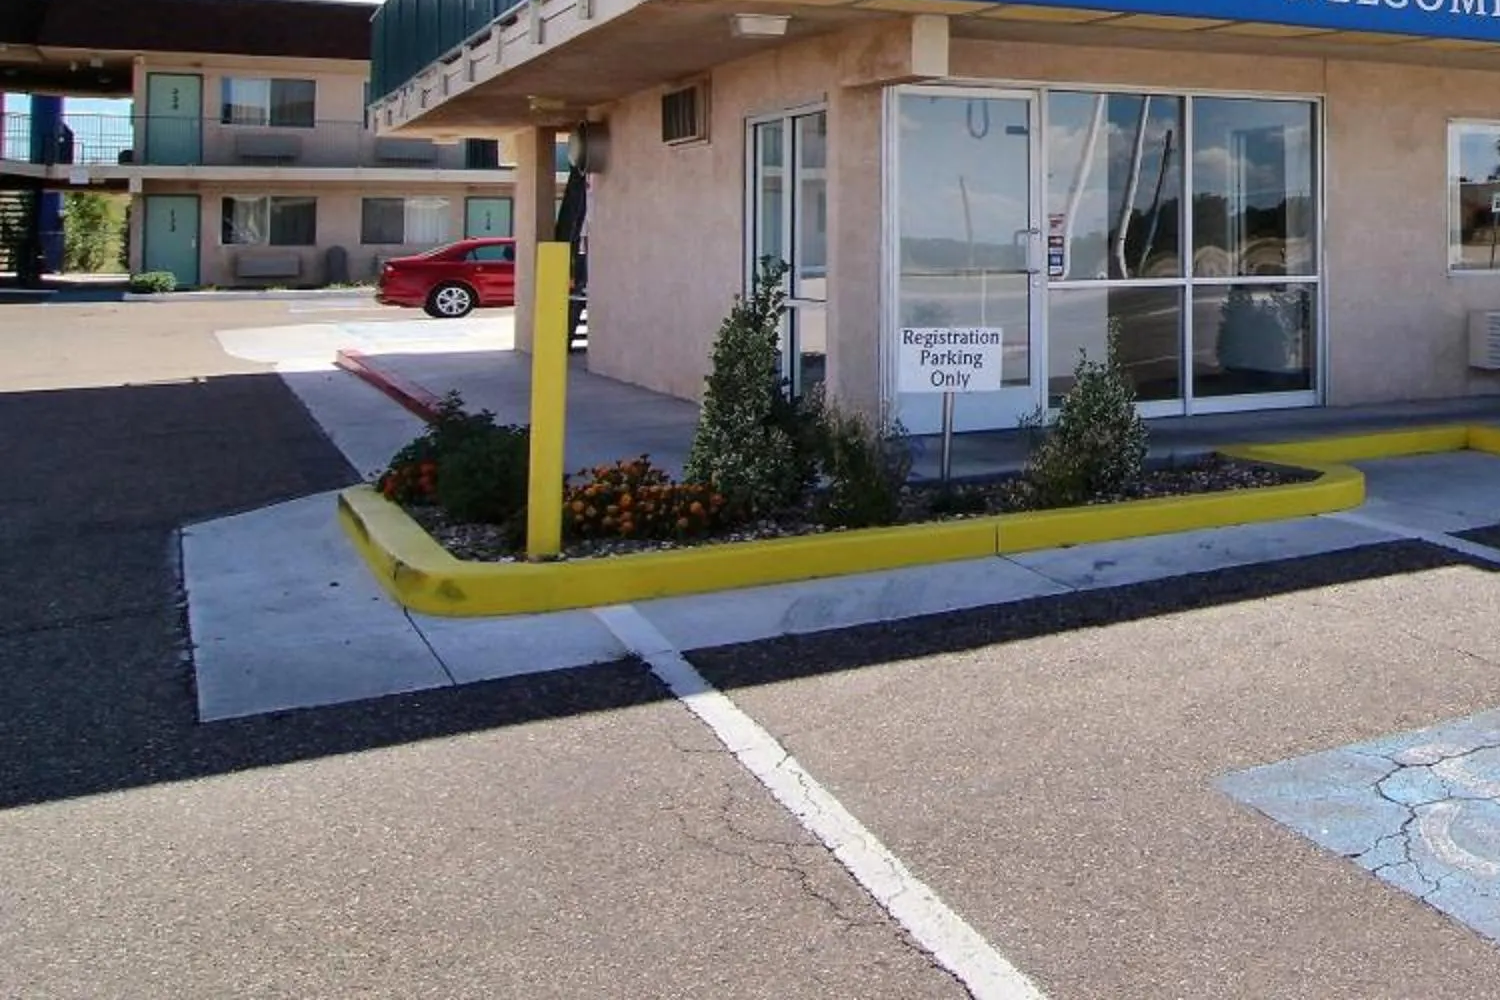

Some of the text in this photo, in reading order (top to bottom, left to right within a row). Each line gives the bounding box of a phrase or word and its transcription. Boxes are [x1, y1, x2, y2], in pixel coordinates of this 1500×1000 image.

[903, 329, 999, 348] Registration
[920, 349, 983, 368] Parking
[930, 370, 971, 388] Only
